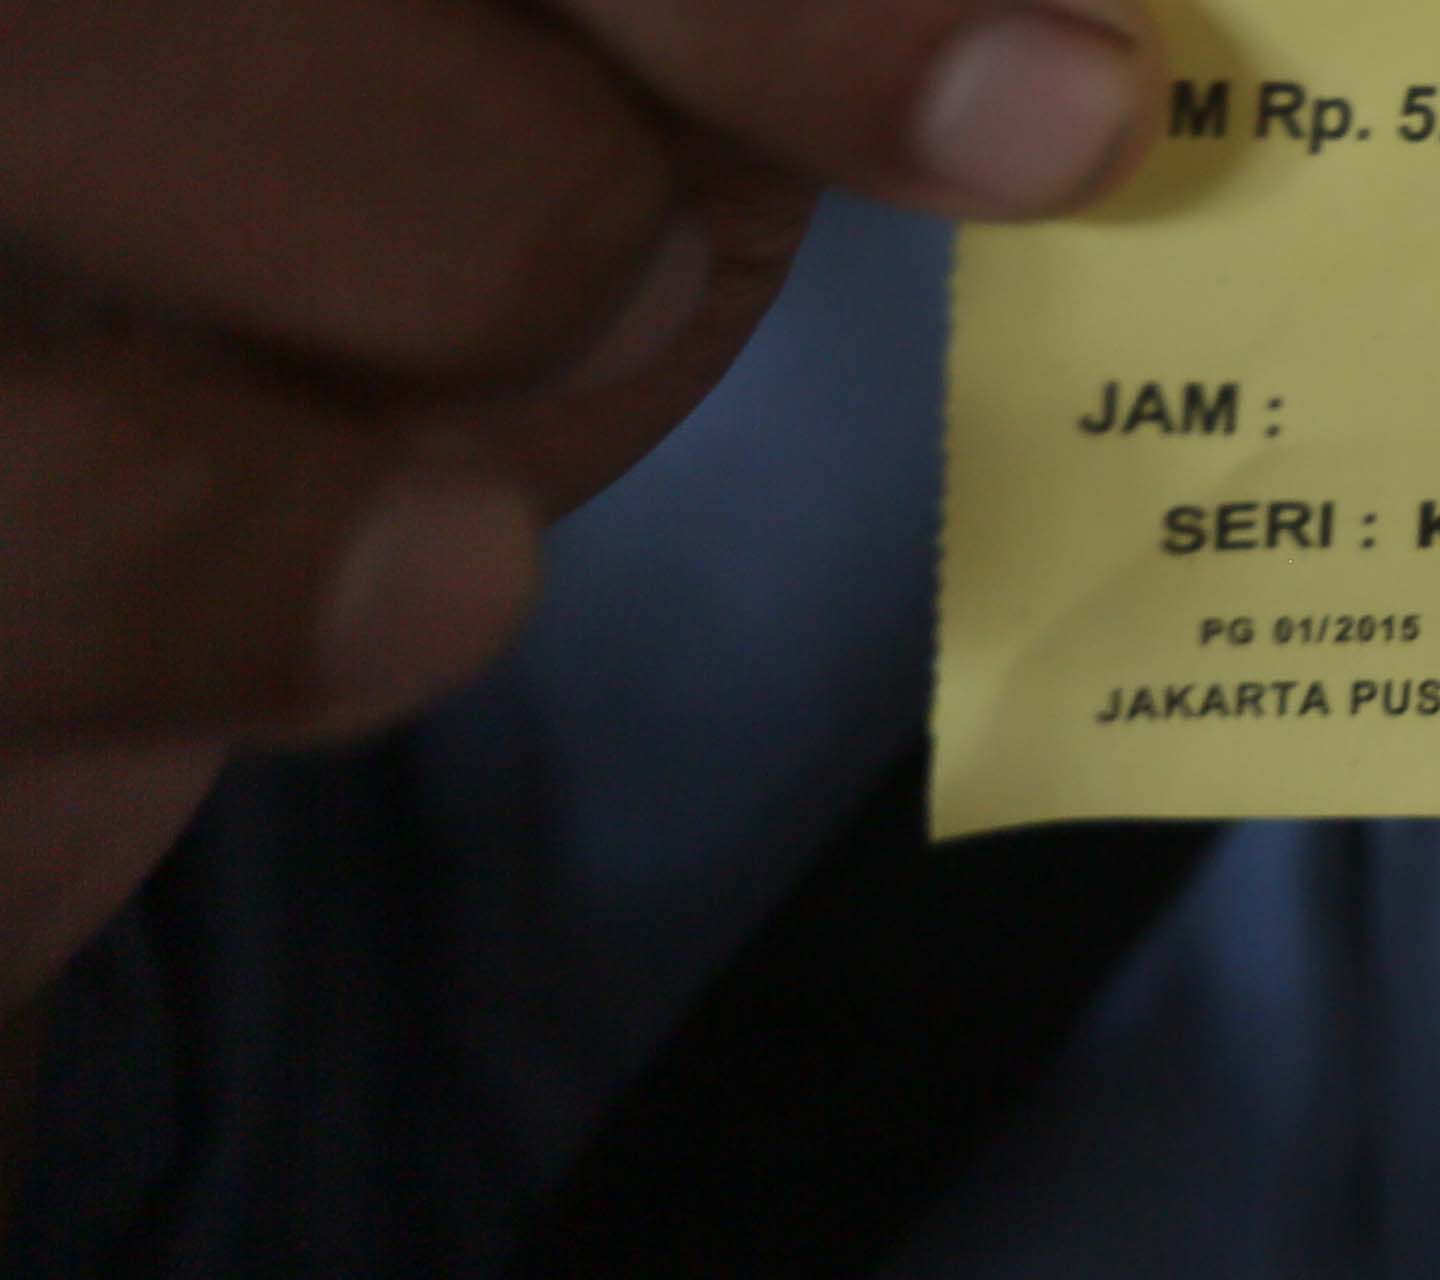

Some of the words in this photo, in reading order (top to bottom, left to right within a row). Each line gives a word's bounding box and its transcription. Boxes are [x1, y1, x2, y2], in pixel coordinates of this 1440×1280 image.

[1250, 76, 1371, 157] Rp.
[1076, 380, 1240, 438] JAM
[1158, 499, 1336, 558] SERI
[1198, 615, 1256, 647] PG
[1270, 613, 1422, 647] 01/2015
[1094, 679, 1332, 726] JAKARTA
